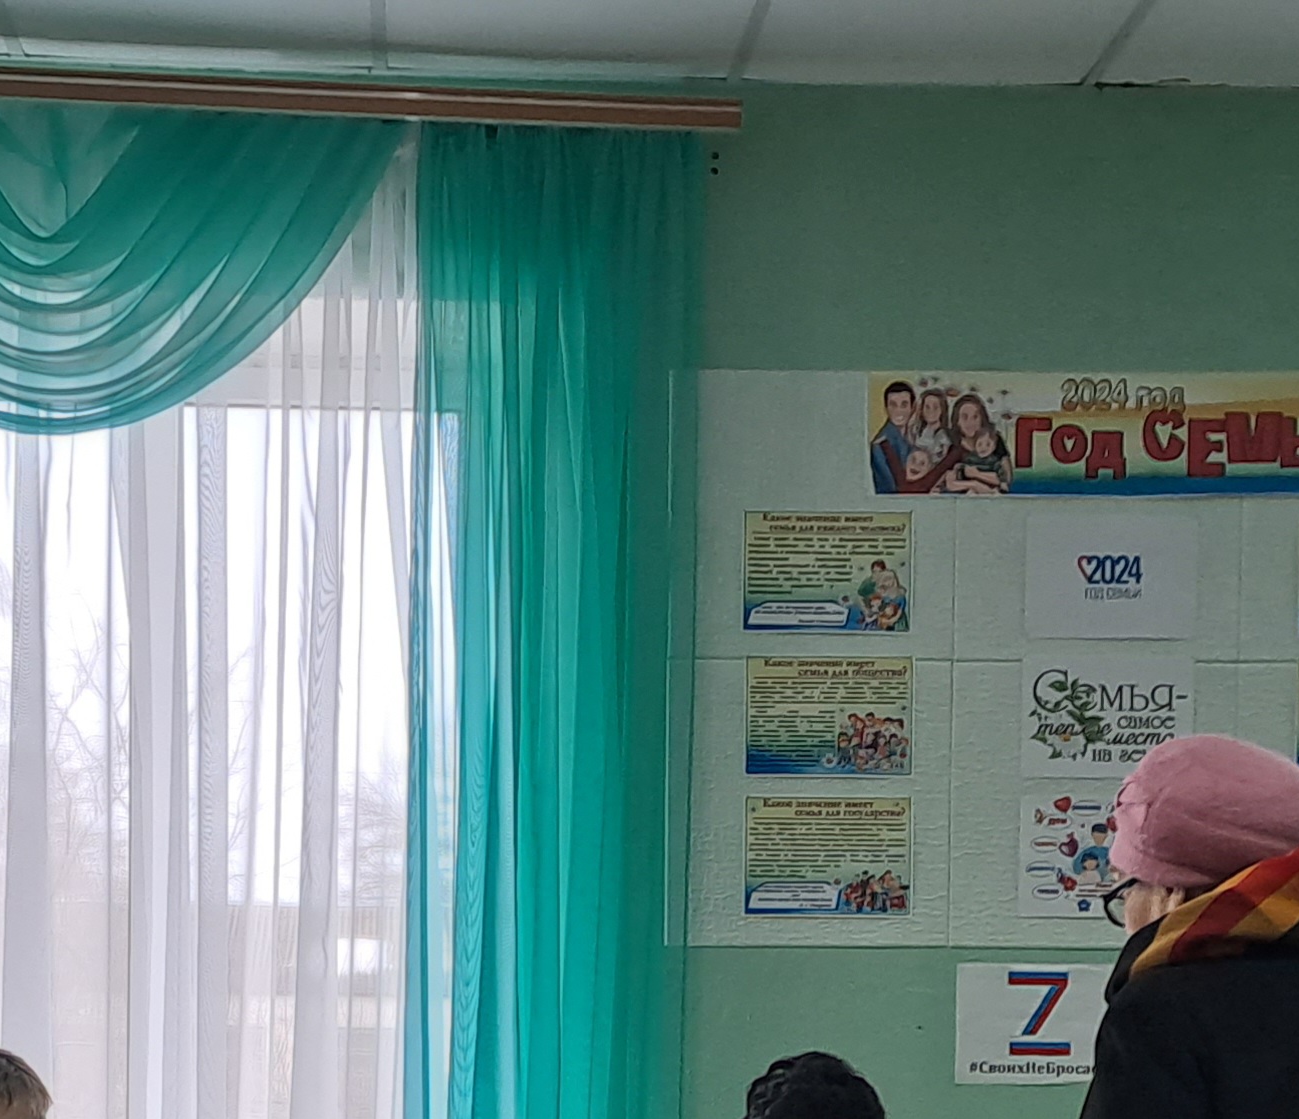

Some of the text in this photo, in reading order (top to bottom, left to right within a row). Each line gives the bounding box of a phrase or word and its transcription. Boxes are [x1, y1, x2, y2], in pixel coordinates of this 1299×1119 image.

[1061, 378, 1186, 412] 2024 год
[1084, 555, 1143, 584] 2024
[1008, 971, 1071, 1056] Z
